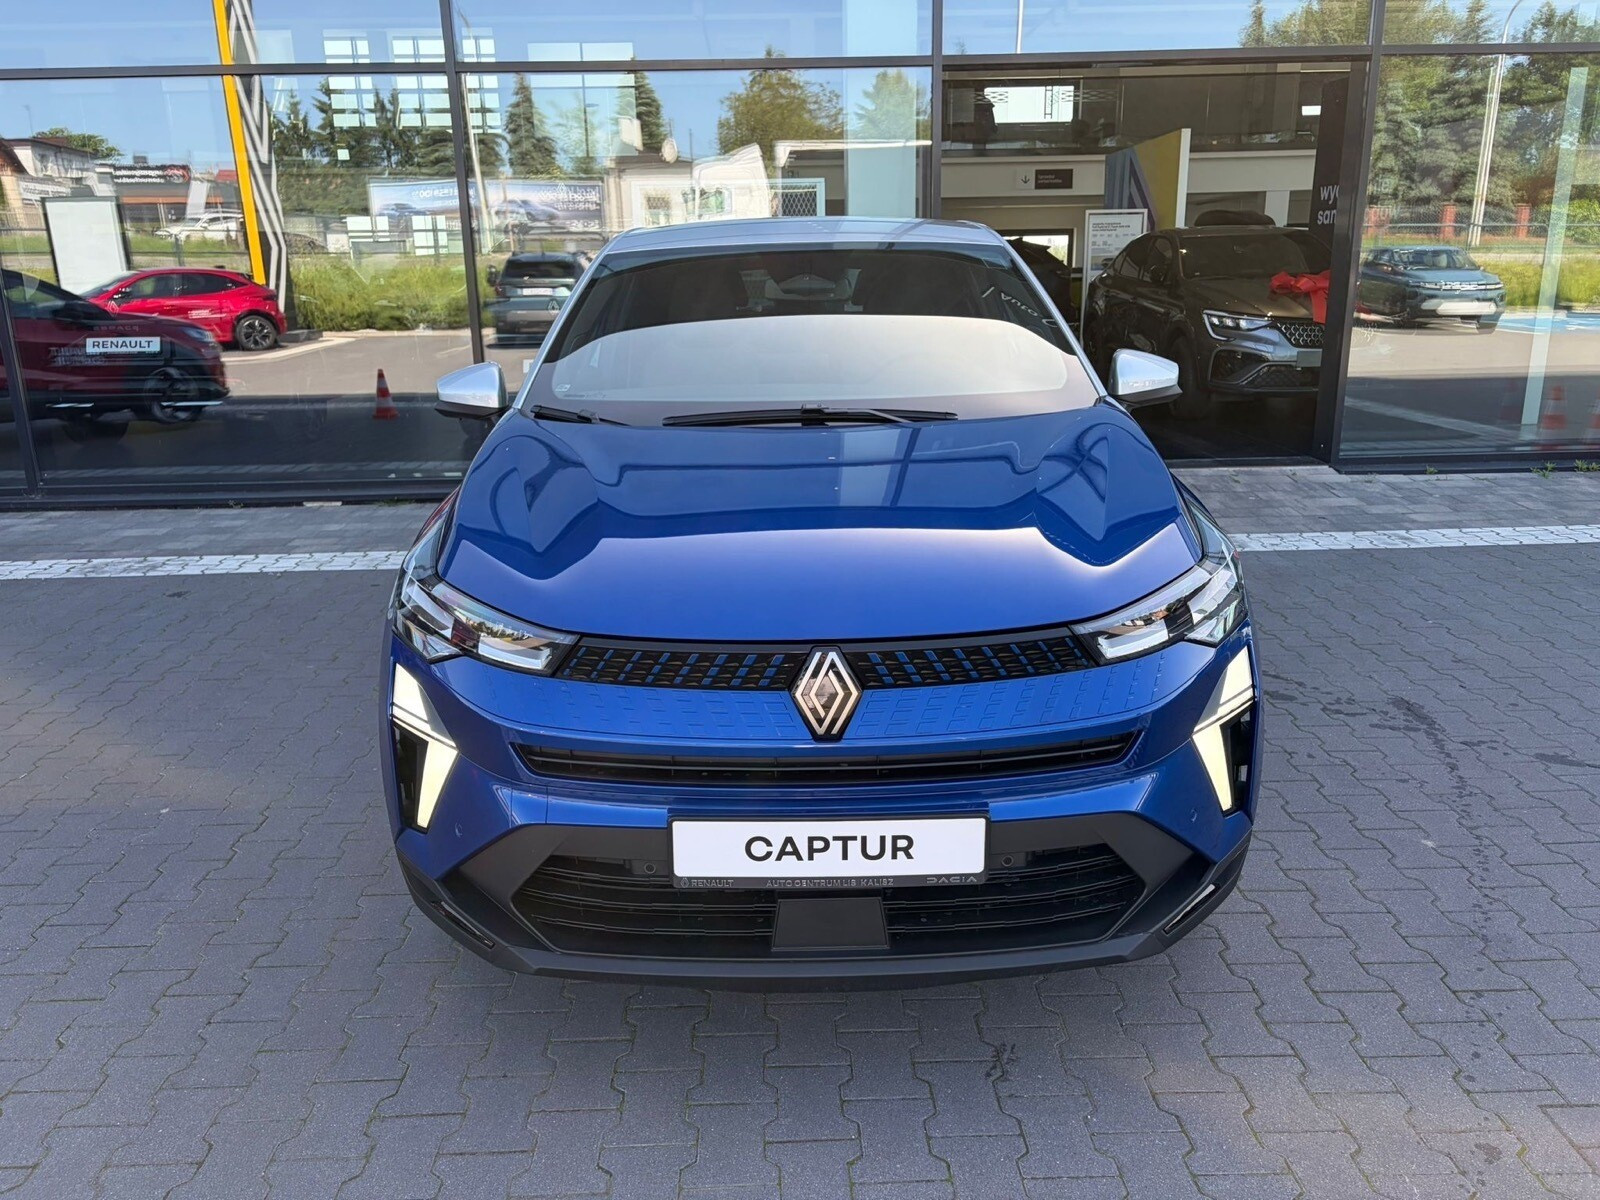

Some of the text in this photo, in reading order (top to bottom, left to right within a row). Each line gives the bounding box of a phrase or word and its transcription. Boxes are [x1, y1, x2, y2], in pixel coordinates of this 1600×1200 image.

[92, 340, 154, 349] RENAULT
[745, 834, 914, 861] CAPTUR
[691, 879, 735, 888] RENAULT
[766, 879, 792, 888] AUTO
[795, 879, 841, 888] CENTRUM
[926, 876, 977, 884] DACIA
